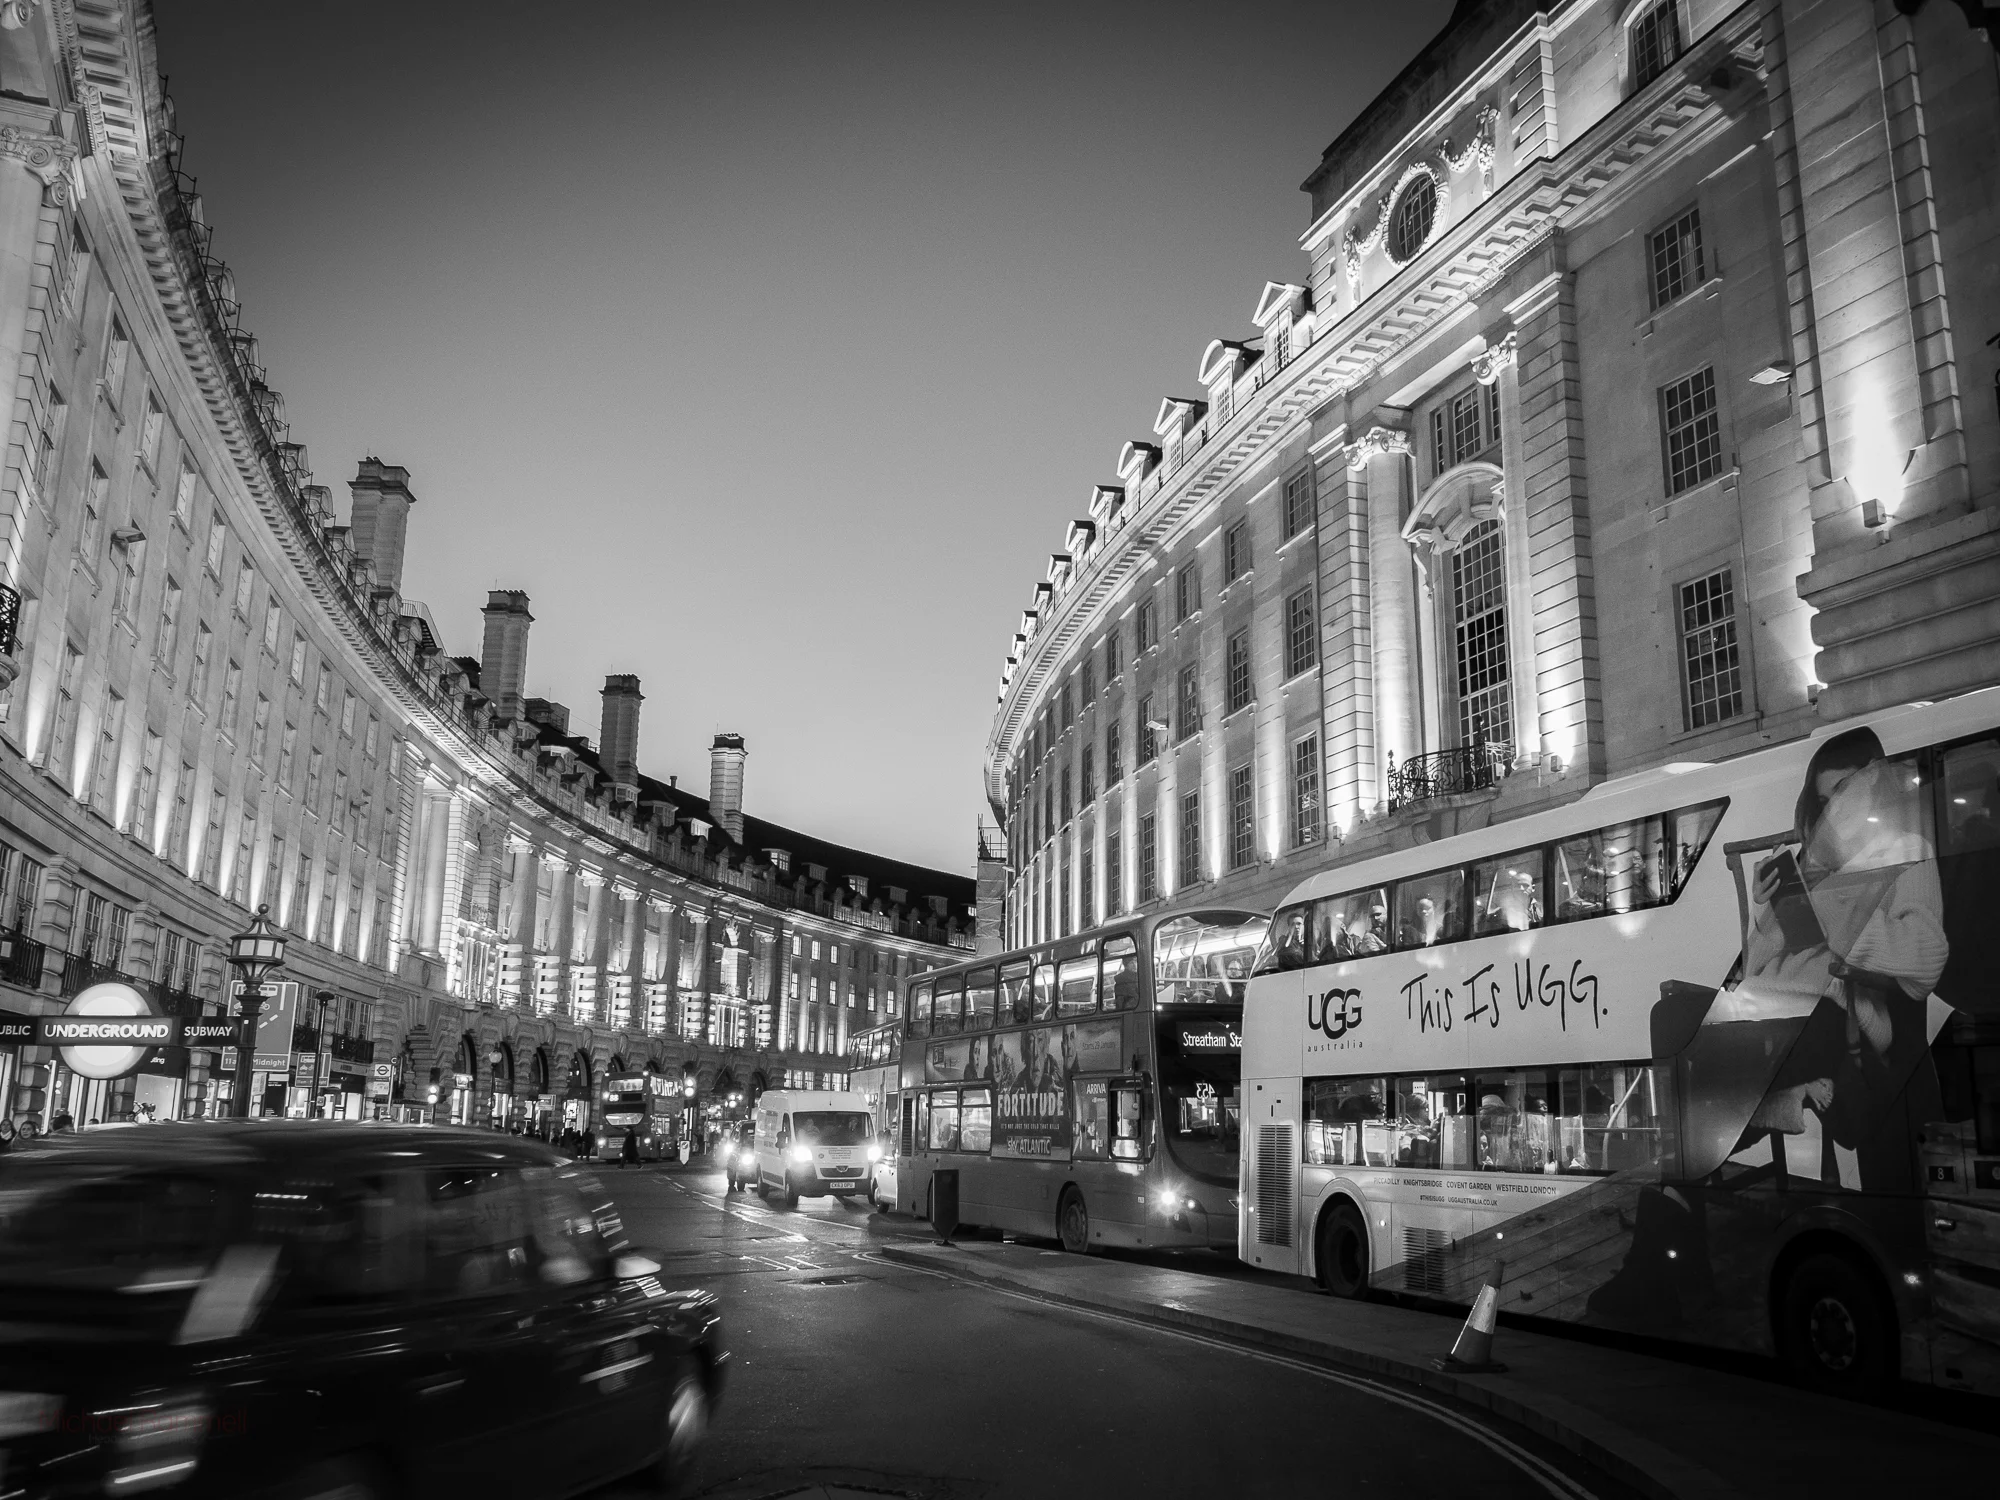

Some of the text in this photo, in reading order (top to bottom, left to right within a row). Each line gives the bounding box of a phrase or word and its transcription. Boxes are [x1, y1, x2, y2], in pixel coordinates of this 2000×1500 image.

[1400, 957, 1609, 1033] This Is UGG.
[1307, 987, 1363, 1040] UGG
[0, 1023, 233, 1039] UBLIC UNDERGROUND SUBWAY
[1182, 1031, 1243, 1048] Streatham Sta
[1307, 1040, 1363, 1052] australia
[252, 1058, 286, 1067] Midnight
[1086, 1083, 1107, 1094] ARRIVA
[997, 1092, 1064, 1117] FORTITUDE
[1007, 1137, 1051, 1154] sky ATLANTIC
[1937, 1167, 1945, 1180] 8
[1373, 1177, 1557, 1195] PICCADILLY KNIGHTSBRIDGE COVENT GARDEN WESTFIELD LONDON
[1420, 1195, 1498, 1206] #THISISUGG UGGAUSTRALIA.CO.UK
